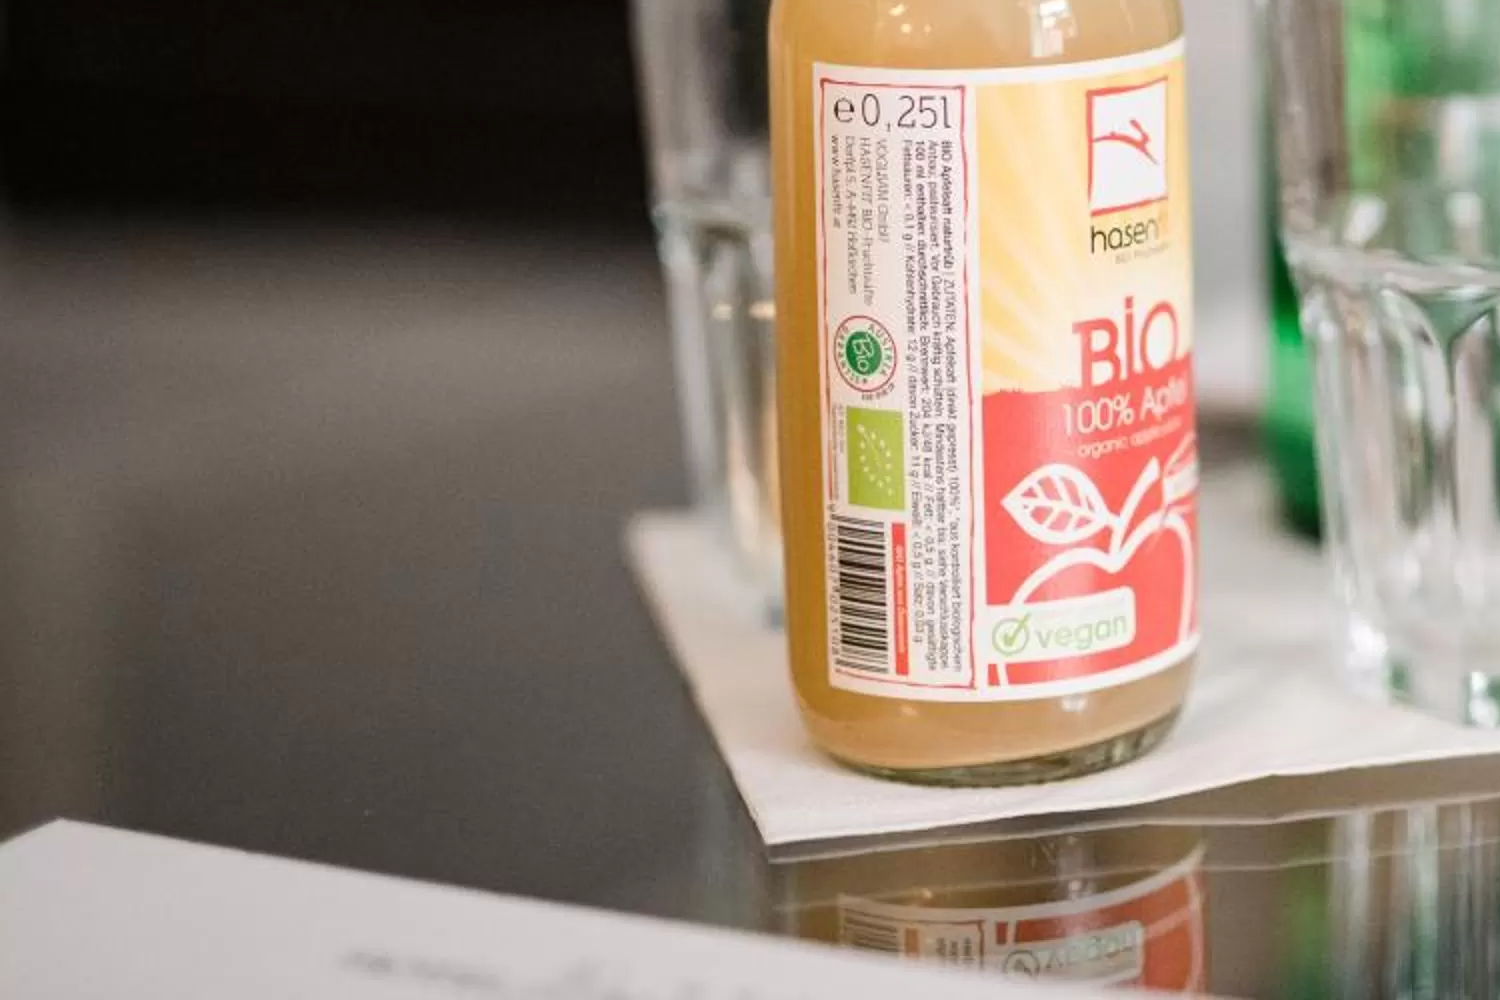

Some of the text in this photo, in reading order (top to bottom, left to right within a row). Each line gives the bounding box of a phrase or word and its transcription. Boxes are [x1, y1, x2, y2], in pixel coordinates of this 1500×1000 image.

[1063, 391, 1135, 437] 100%
[1077, 436, 1128, 460] organic
[1036, 614, 1128, 650] vegan
